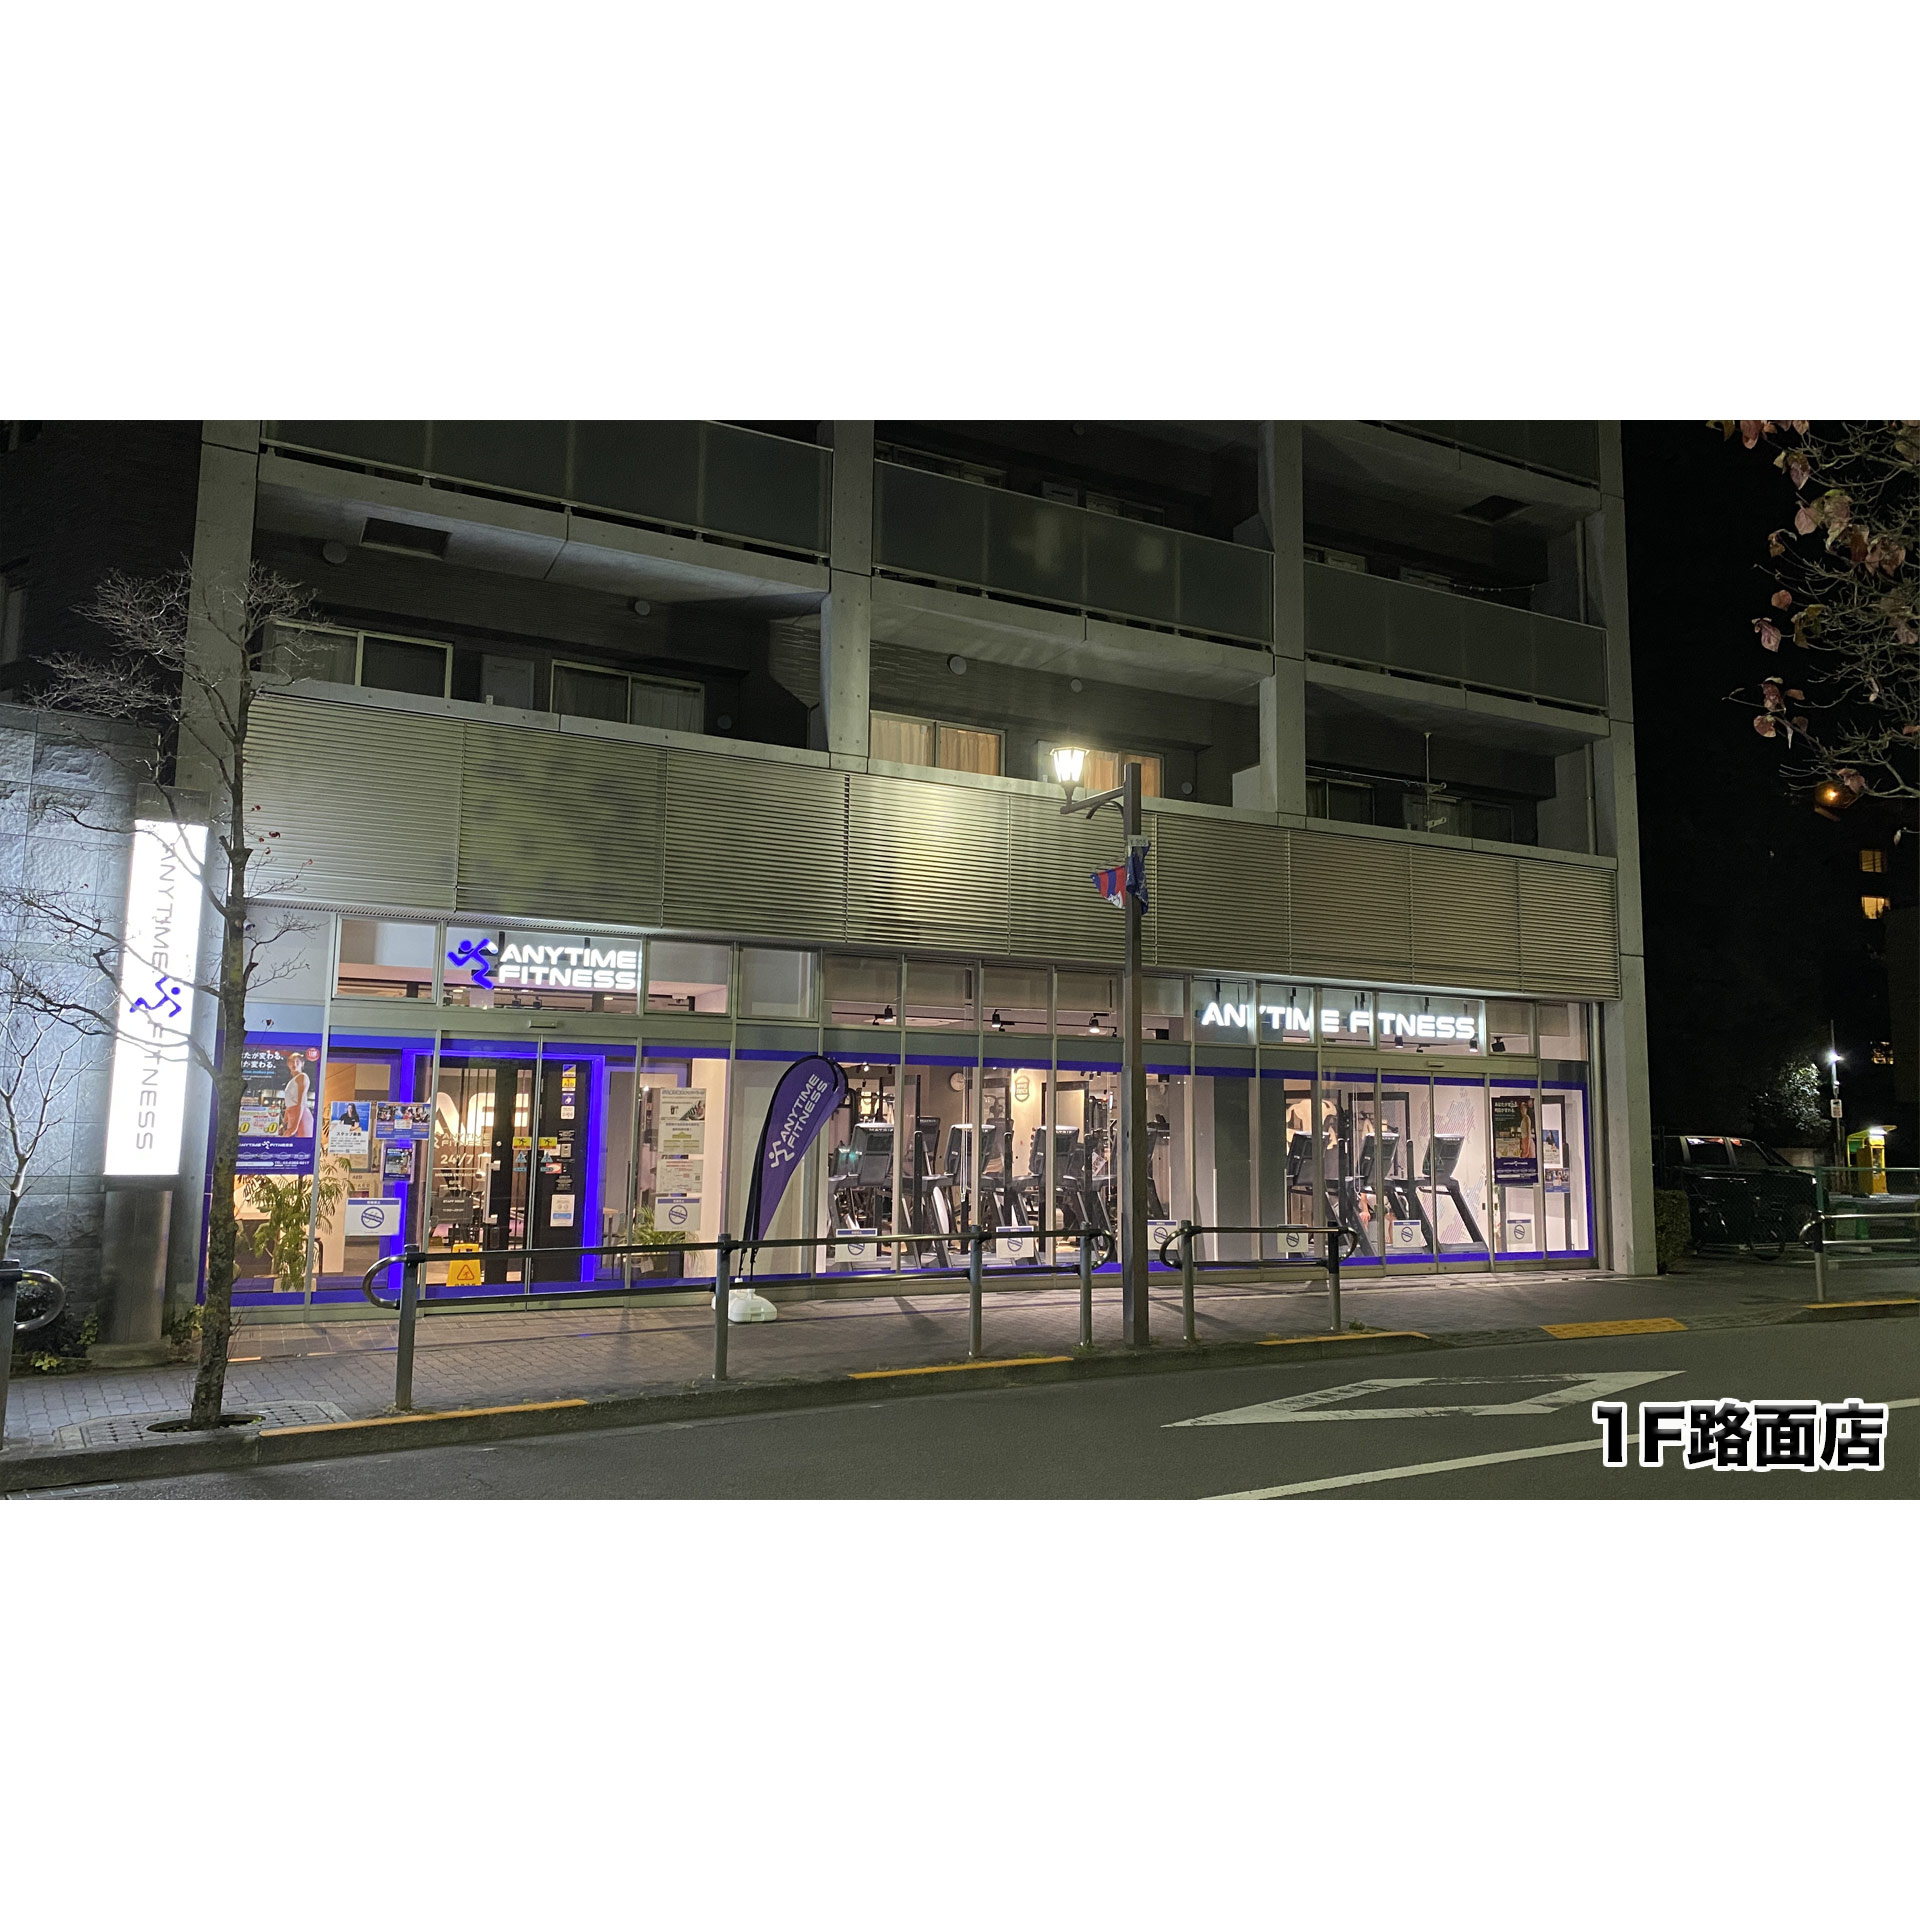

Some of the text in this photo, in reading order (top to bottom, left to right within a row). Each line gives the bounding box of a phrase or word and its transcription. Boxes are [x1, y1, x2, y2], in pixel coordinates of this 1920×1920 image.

[498, 965, 637, 991] FITNESS
[500, 944, 638, 970] ANYTIME
[1349, 1010, 1476, 1040] FTNESS
[136, 1022, 162, 1150] FTNESS
[779, 1073, 820, 1143] ANYTIME
[786, 1080, 828, 1149] FITNESS
